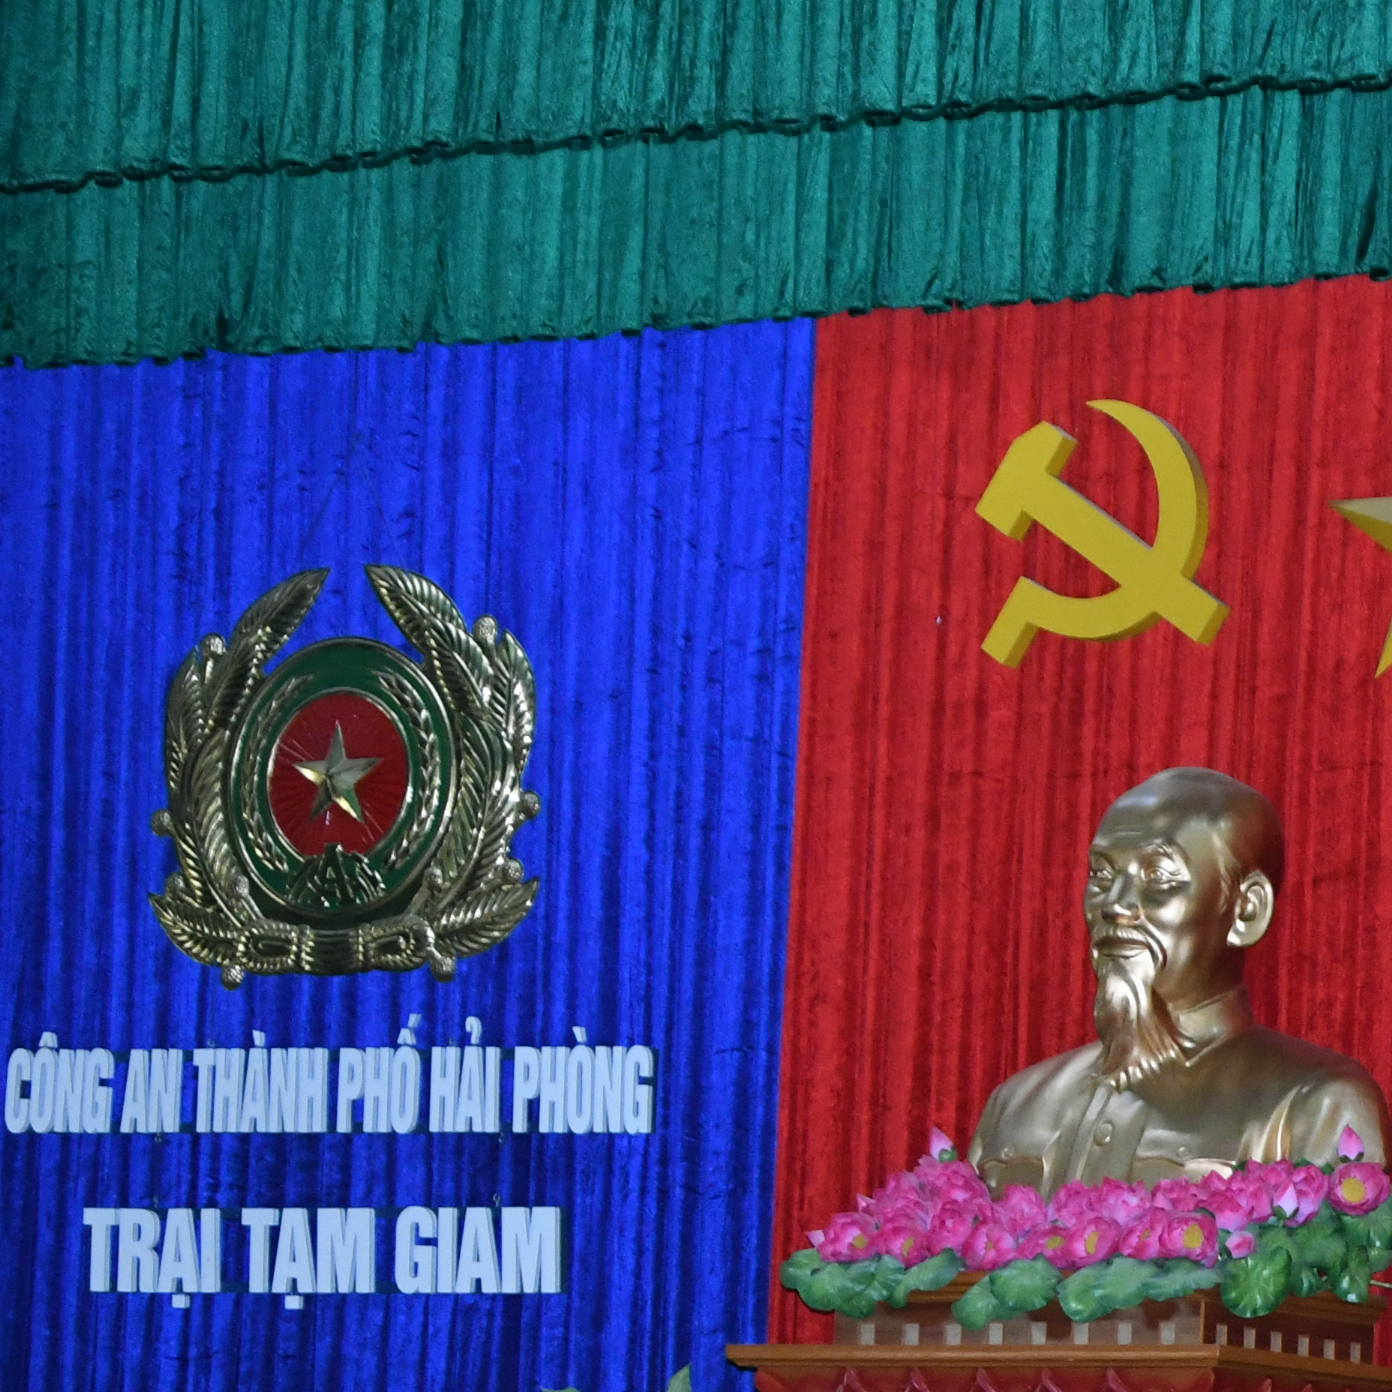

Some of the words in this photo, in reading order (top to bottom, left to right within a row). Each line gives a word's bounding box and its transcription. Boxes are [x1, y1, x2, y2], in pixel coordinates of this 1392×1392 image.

[5, 1031, 114, 1134] CÔNG
[120, 1049, 183, 1133] AN
[193, 1030, 329, 1133] THÀNH
[336, 1013, 421, 1134] PHỐ
[428, 1016, 500, 1133] HẢI
[512, 1026, 654, 1134] PHÒNG
[83, 1207, 221, 1309] TRẠI
[241, 1207, 376, 1309] TẠM
[394, 1206, 562, 1294] GIAM
